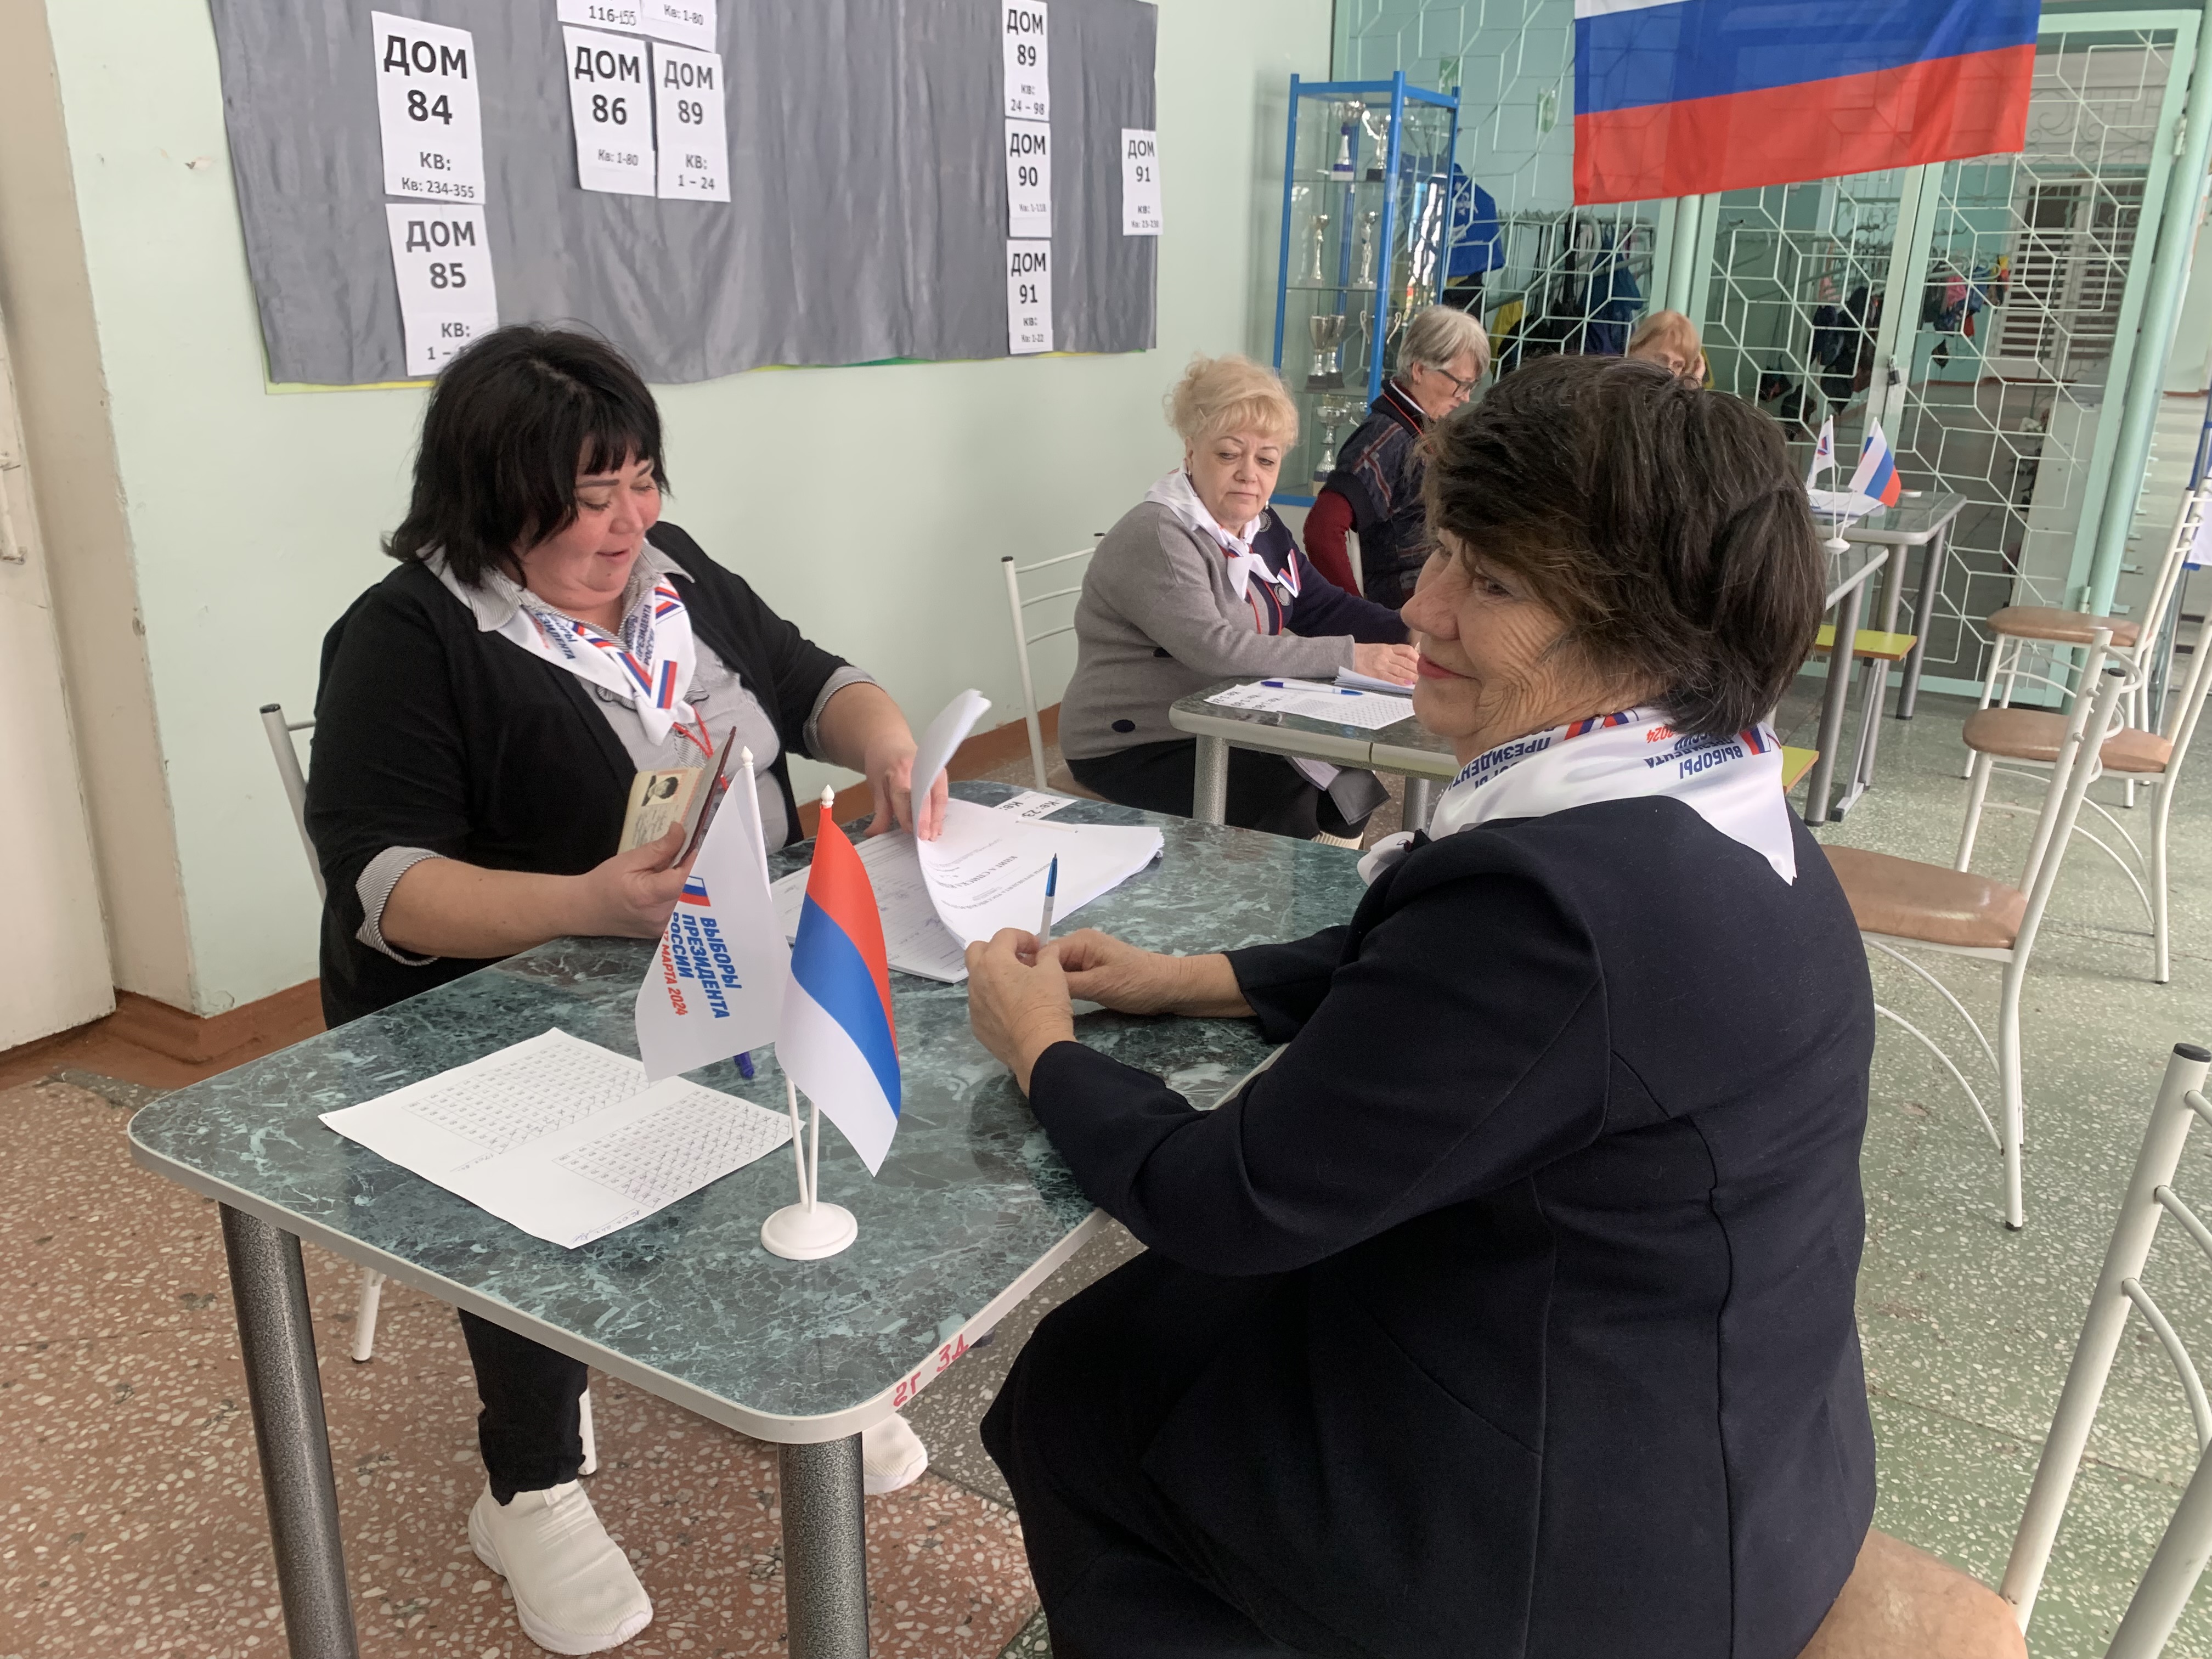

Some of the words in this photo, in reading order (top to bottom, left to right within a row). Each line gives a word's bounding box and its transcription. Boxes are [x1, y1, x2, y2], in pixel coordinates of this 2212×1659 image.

[588, 5, 637, 26] 116-155
[1007, 9, 1043, 35] ДОМ
[383, 35, 468, 80] ДОМ
[575, 46, 640, 84] ДОМ
[1018, 44, 1036, 66] 89
[664, 60, 714, 90] ДОМ
[407, 89, 453, 125] 84
[592, 94, 627, 125] 86
[678, 99, 703, 125] 89
[1011, 99, 1022, 111] 24
[597, 149, 615, 162] Кв:
[1010, 133, 1046, 157] ДОМ
[1127, 140, 1155, 160] ДОМ
[420, 151, 451, 171] КВ:
[686, 154, 708, 170] КВ:
[701, 177, 715, 190] 24
[1019, 166, 1038, 187] 90
[1136, 166, 1151, 182] 91
[402, 177, 423, 192] Кв:
[426, 180, 475, 199] 234-355
[405, 221, 476, 252] ДОМ
[430, 262, 466, 289] 85
[1011, 252, 1046, 277] ДОМ
[1020, 284, 1038, 304] 91
[441, 323, 471, 338] КВ:
[1679, 746, 1743, 780] ВЫБОРЫ
[1022, 809, 1042, 818] 23
[662, 944, 678, 985] МАРТА
[699, 917, 742, 989] ВЫБОРЫ
[682, 914, 730, 1018] ПРЕЗИДЕНТА
[668, 987, 689, 1017] 2024
